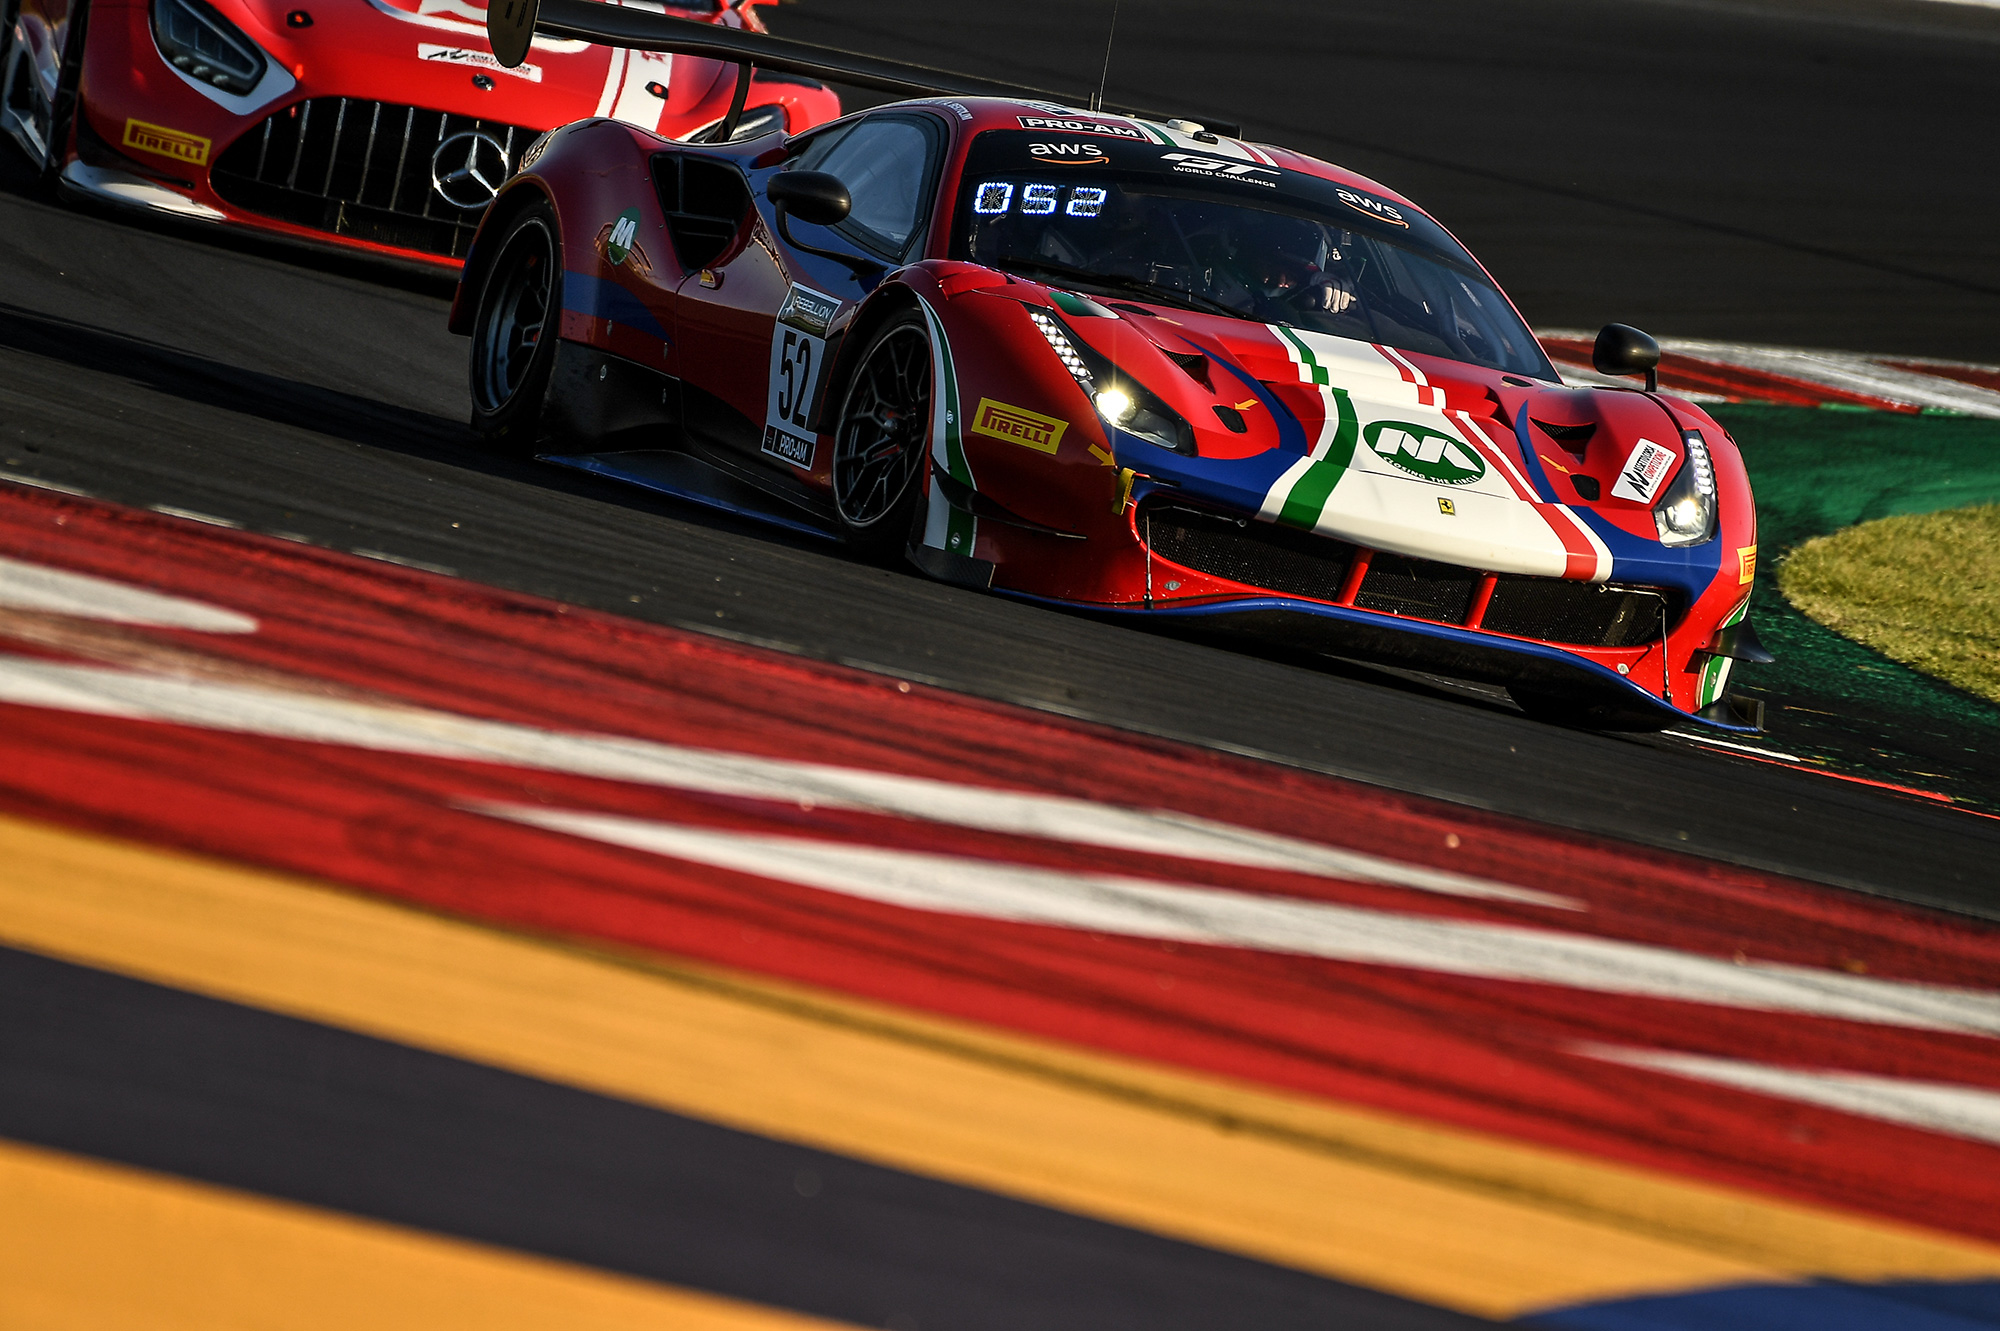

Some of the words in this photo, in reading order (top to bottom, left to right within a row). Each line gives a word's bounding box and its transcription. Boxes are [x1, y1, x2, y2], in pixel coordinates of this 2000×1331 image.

[128, 123, 205, 160] PIRELLI
[1025, 118, 1139, 138] PRO-AM
[1028, 143, 1103, 156] aws
[1173, 166, 1213, 176] WORLD
[1215, 172, 1277, 188] CHALLENGE
[974, 182, 1107, 217] 052
[1335, 188, 1403, 220] aws
[794, 295, 831, 319] REBELLION
[778, 330, 811, 429] 52
[981, 405, 1055, 446] PIRELLI
[779, 434, 808, 462] PRO-AM
[1383, 456, 1426, 479] CLOSING
[1429, 476, 1450, 485] THE
[1453, 474, 1480, 485] CIRCLE
